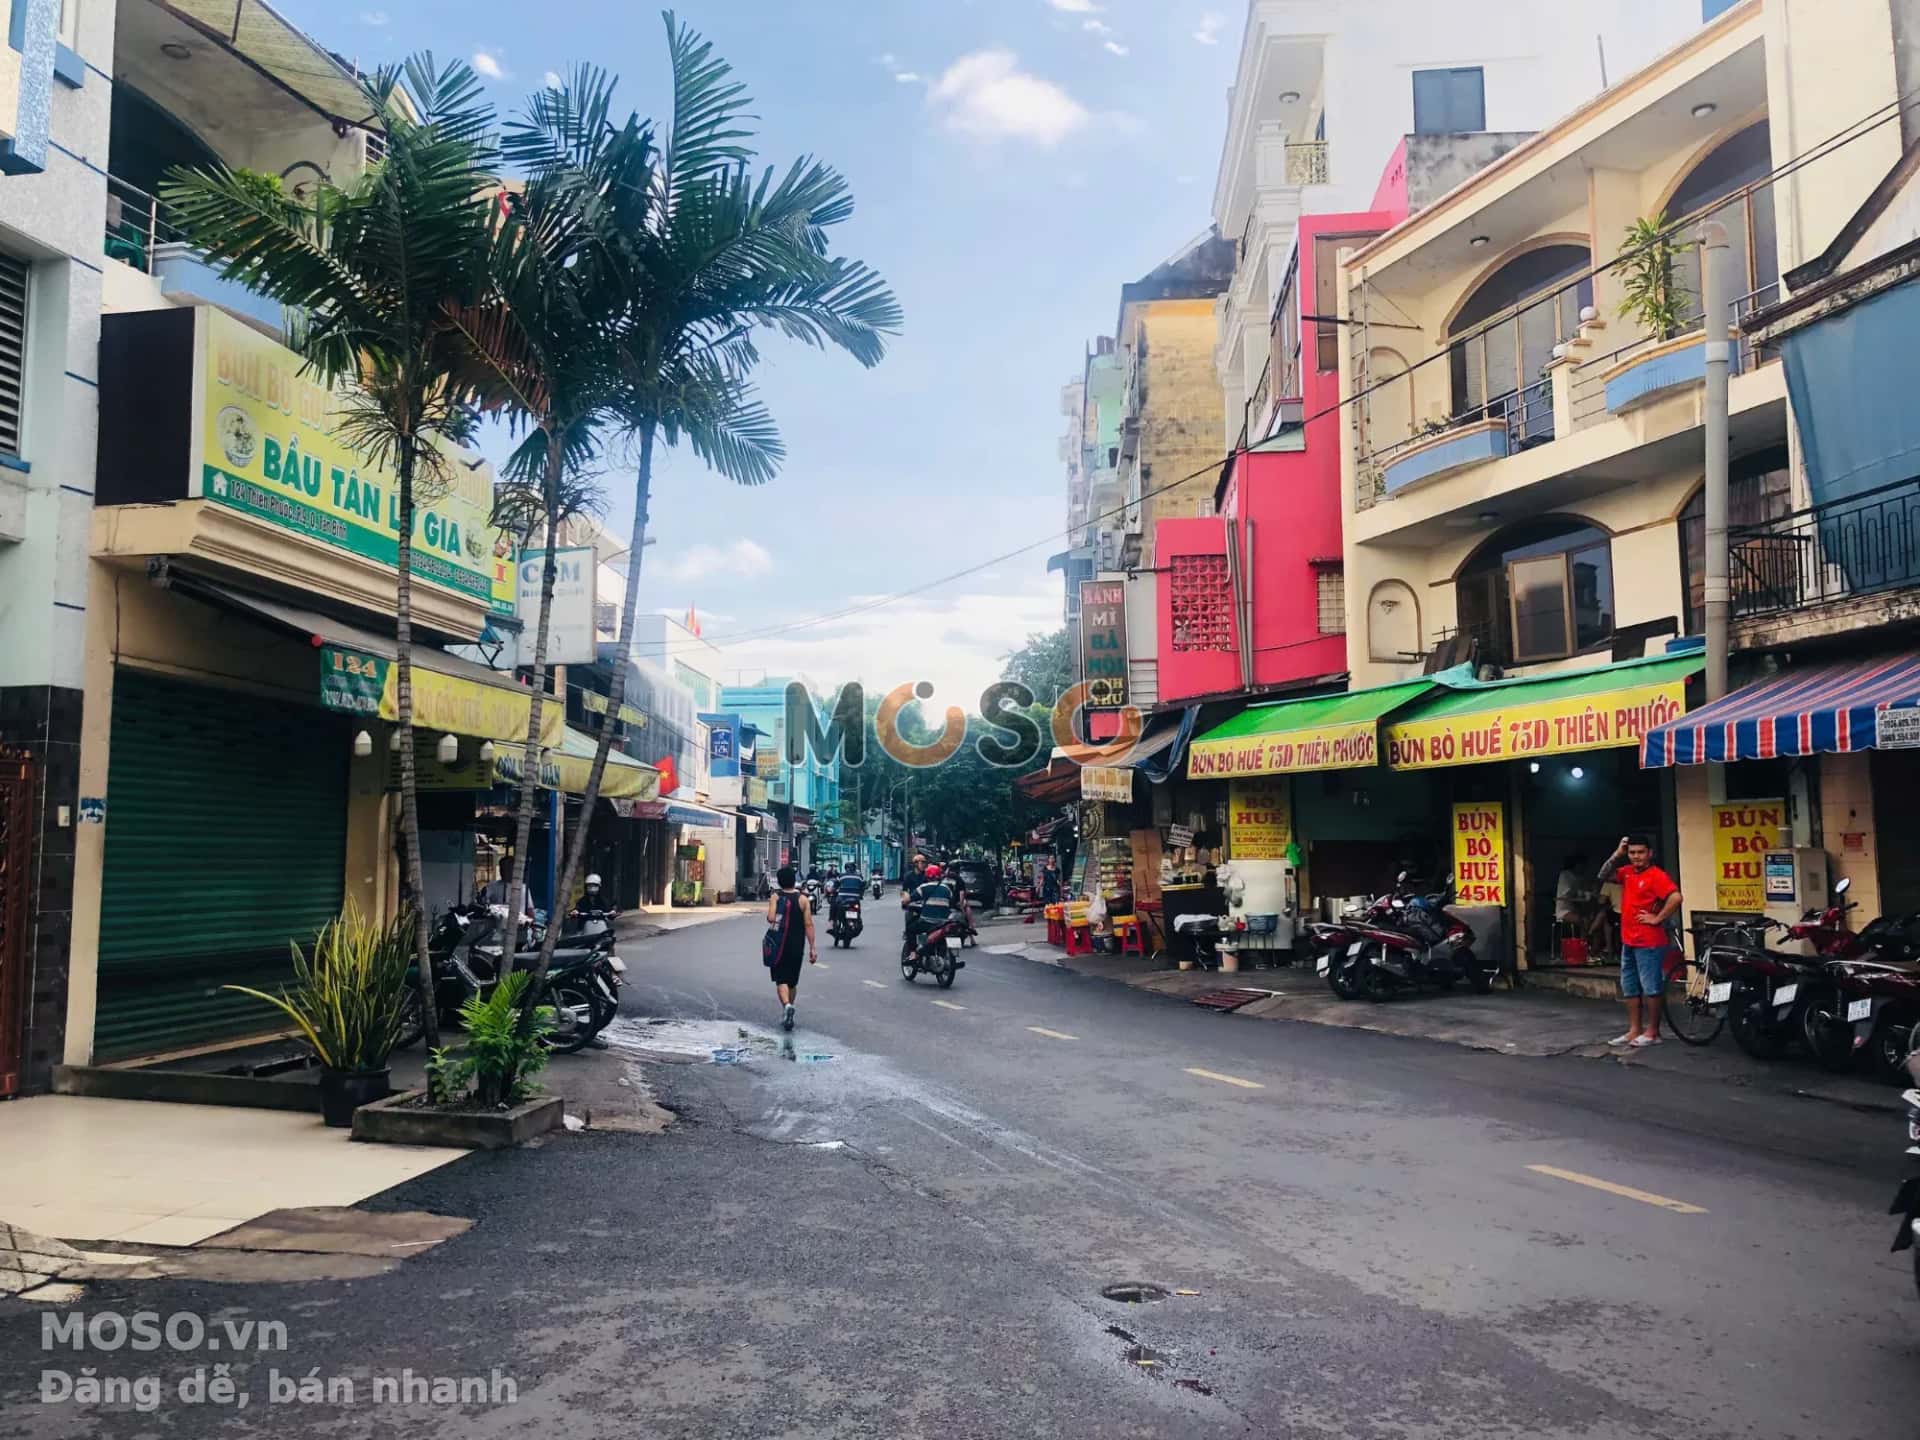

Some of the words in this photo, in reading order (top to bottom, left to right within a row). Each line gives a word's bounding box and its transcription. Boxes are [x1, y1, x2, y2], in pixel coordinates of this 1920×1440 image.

[230, 480, 246, 500] 124
[330, 465, 381, 524] TÂN
[424, 510, 461, 557] GIA
[1083, 584, 1122, 605] BÁNH
[1092, 607, 1117, 626] MÌ
[333, 652, 377, 679] 124
[1389, 732, 1425, 765] BÚN
[1430, 727, 1456, 762] BÒ
[1461, 715, 1502, 757] HUẾ
[1509, 719, 1549, 752] 75D
[1554, 705, 1608, 746] THIÊN
[1191, 748, 1216, 774] BÚN
[1218, 745, 1234, 772] BÒ
[1237, 738, 1263, 770] HUẾ
[1268, 743, 1293, 769] 75D
[1297, 735, 1330, 766] THIÊN
[1333, 729, 1374, 762] PHƯỚC
[1457, 807, 1498, 831] BÚN
[1718, 804, 1779, 828] BÚN
[1466, 832, 1492, 856] BÒ
[1731, 831, 1769, 854] BÒ
[1459, 853, 1499, 881] HUẾ
[1457, 884, 1501, 902] 45K
